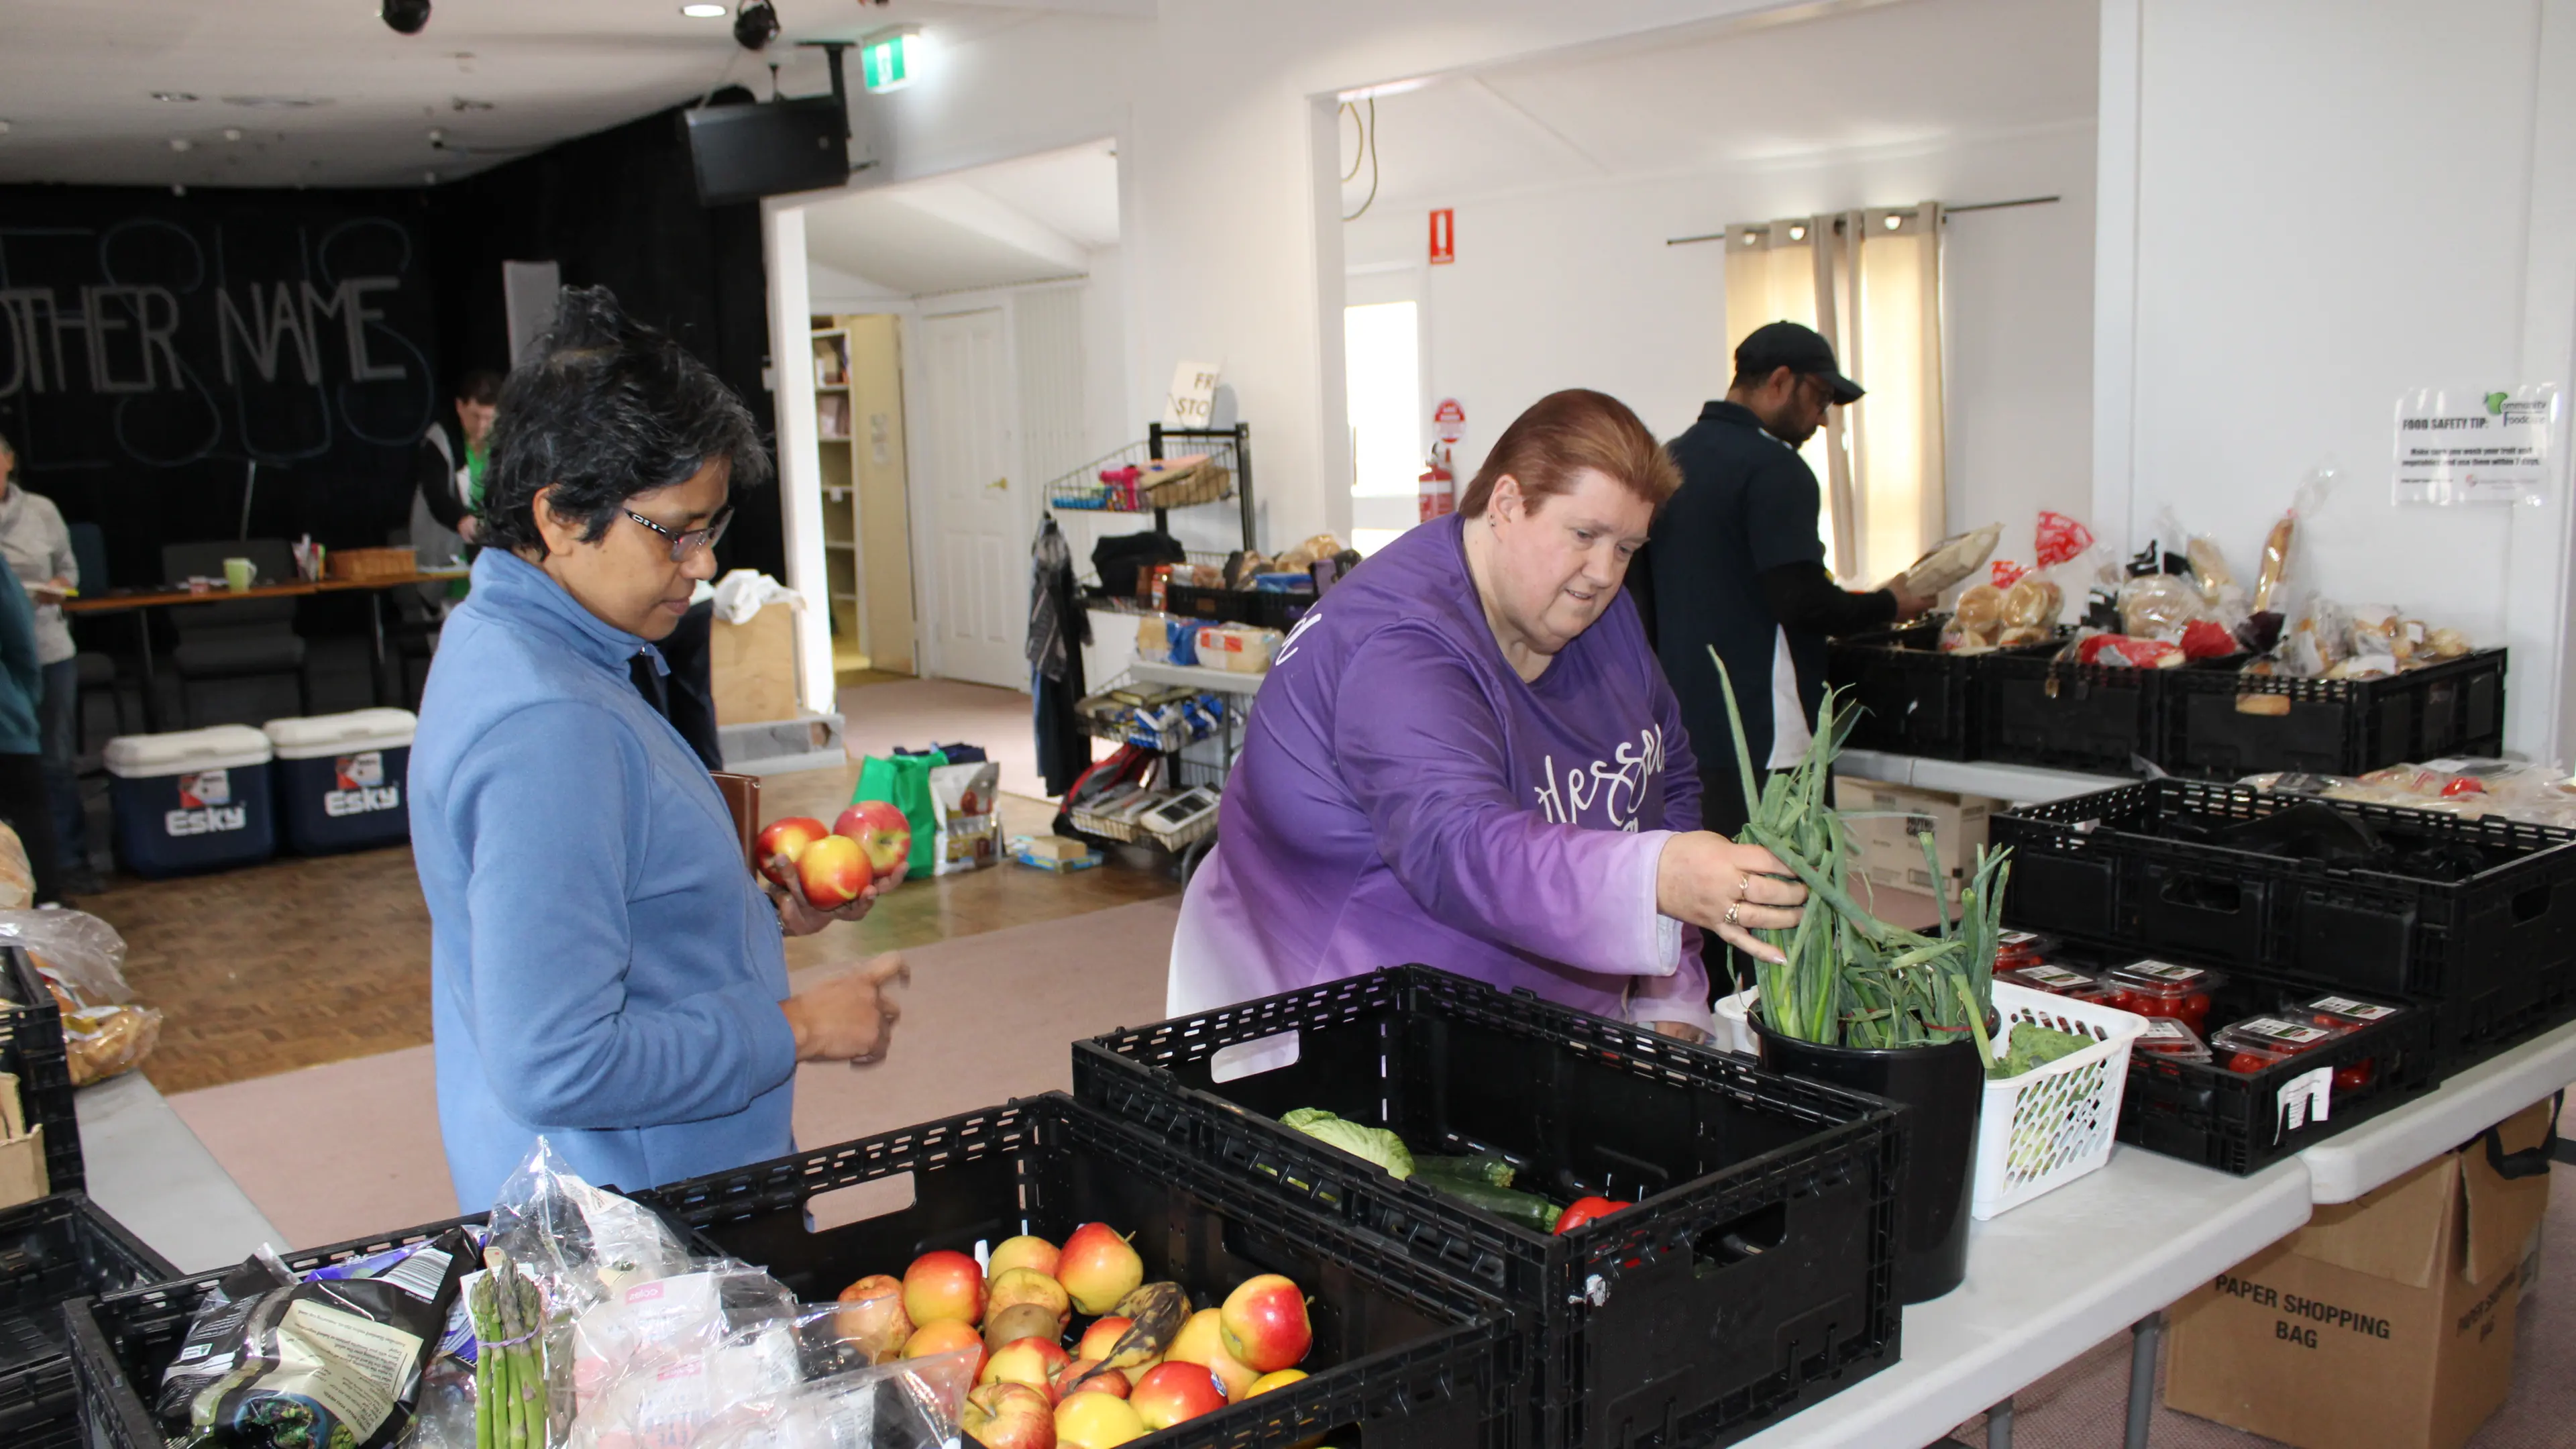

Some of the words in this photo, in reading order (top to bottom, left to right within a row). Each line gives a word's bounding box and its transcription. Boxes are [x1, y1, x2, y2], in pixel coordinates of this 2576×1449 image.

[215, 276, 407, 385] NAME
[2403, 419, 2428, 431] FOOD
[2431, 419, 2467, 430] SAFETY
[325, 785, 399, 817] Esky
[165, 804, 246, 837] Esky
[2215, 1275, 2277, 1308] PAPER
[2284, 1294, 2391, 1339] SHOPPING
[2275, 1321, 2318, 1349] BAG
